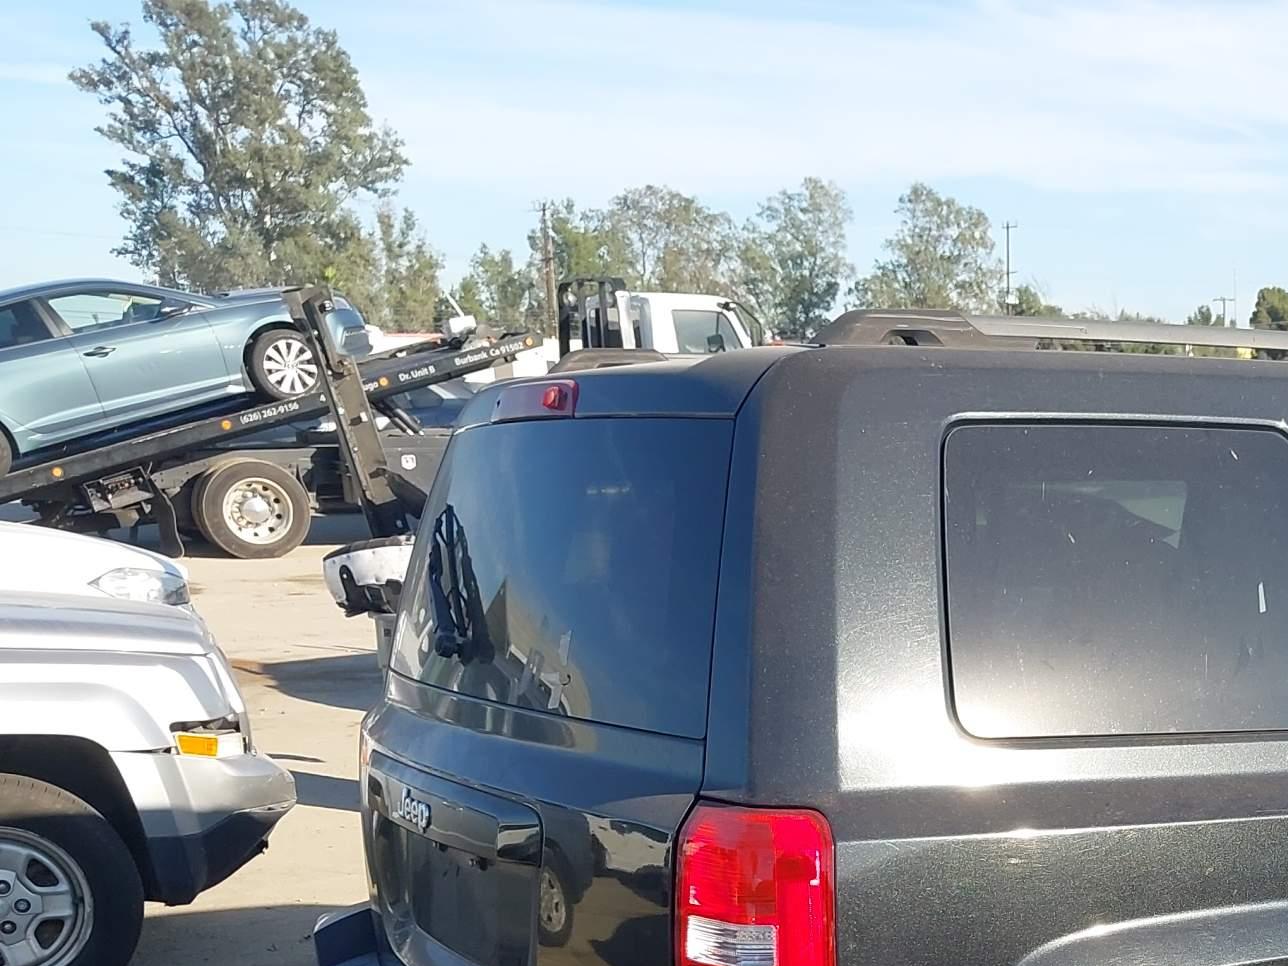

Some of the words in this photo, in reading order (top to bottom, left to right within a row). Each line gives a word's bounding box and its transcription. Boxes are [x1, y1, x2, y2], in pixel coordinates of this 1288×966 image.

[454, 351, 488, 366] Burbank
[489, 347, 500, 356] Ca
[500, 341, 524, 354] 91502
[398, 373, 411, 382] Dr.
[410, 368, 428, 378] Unit
[239, 411, 262, 425] (626)
[262, 401, 300, 419] 262-9156
[396, 786, 432, 834] Jeep
